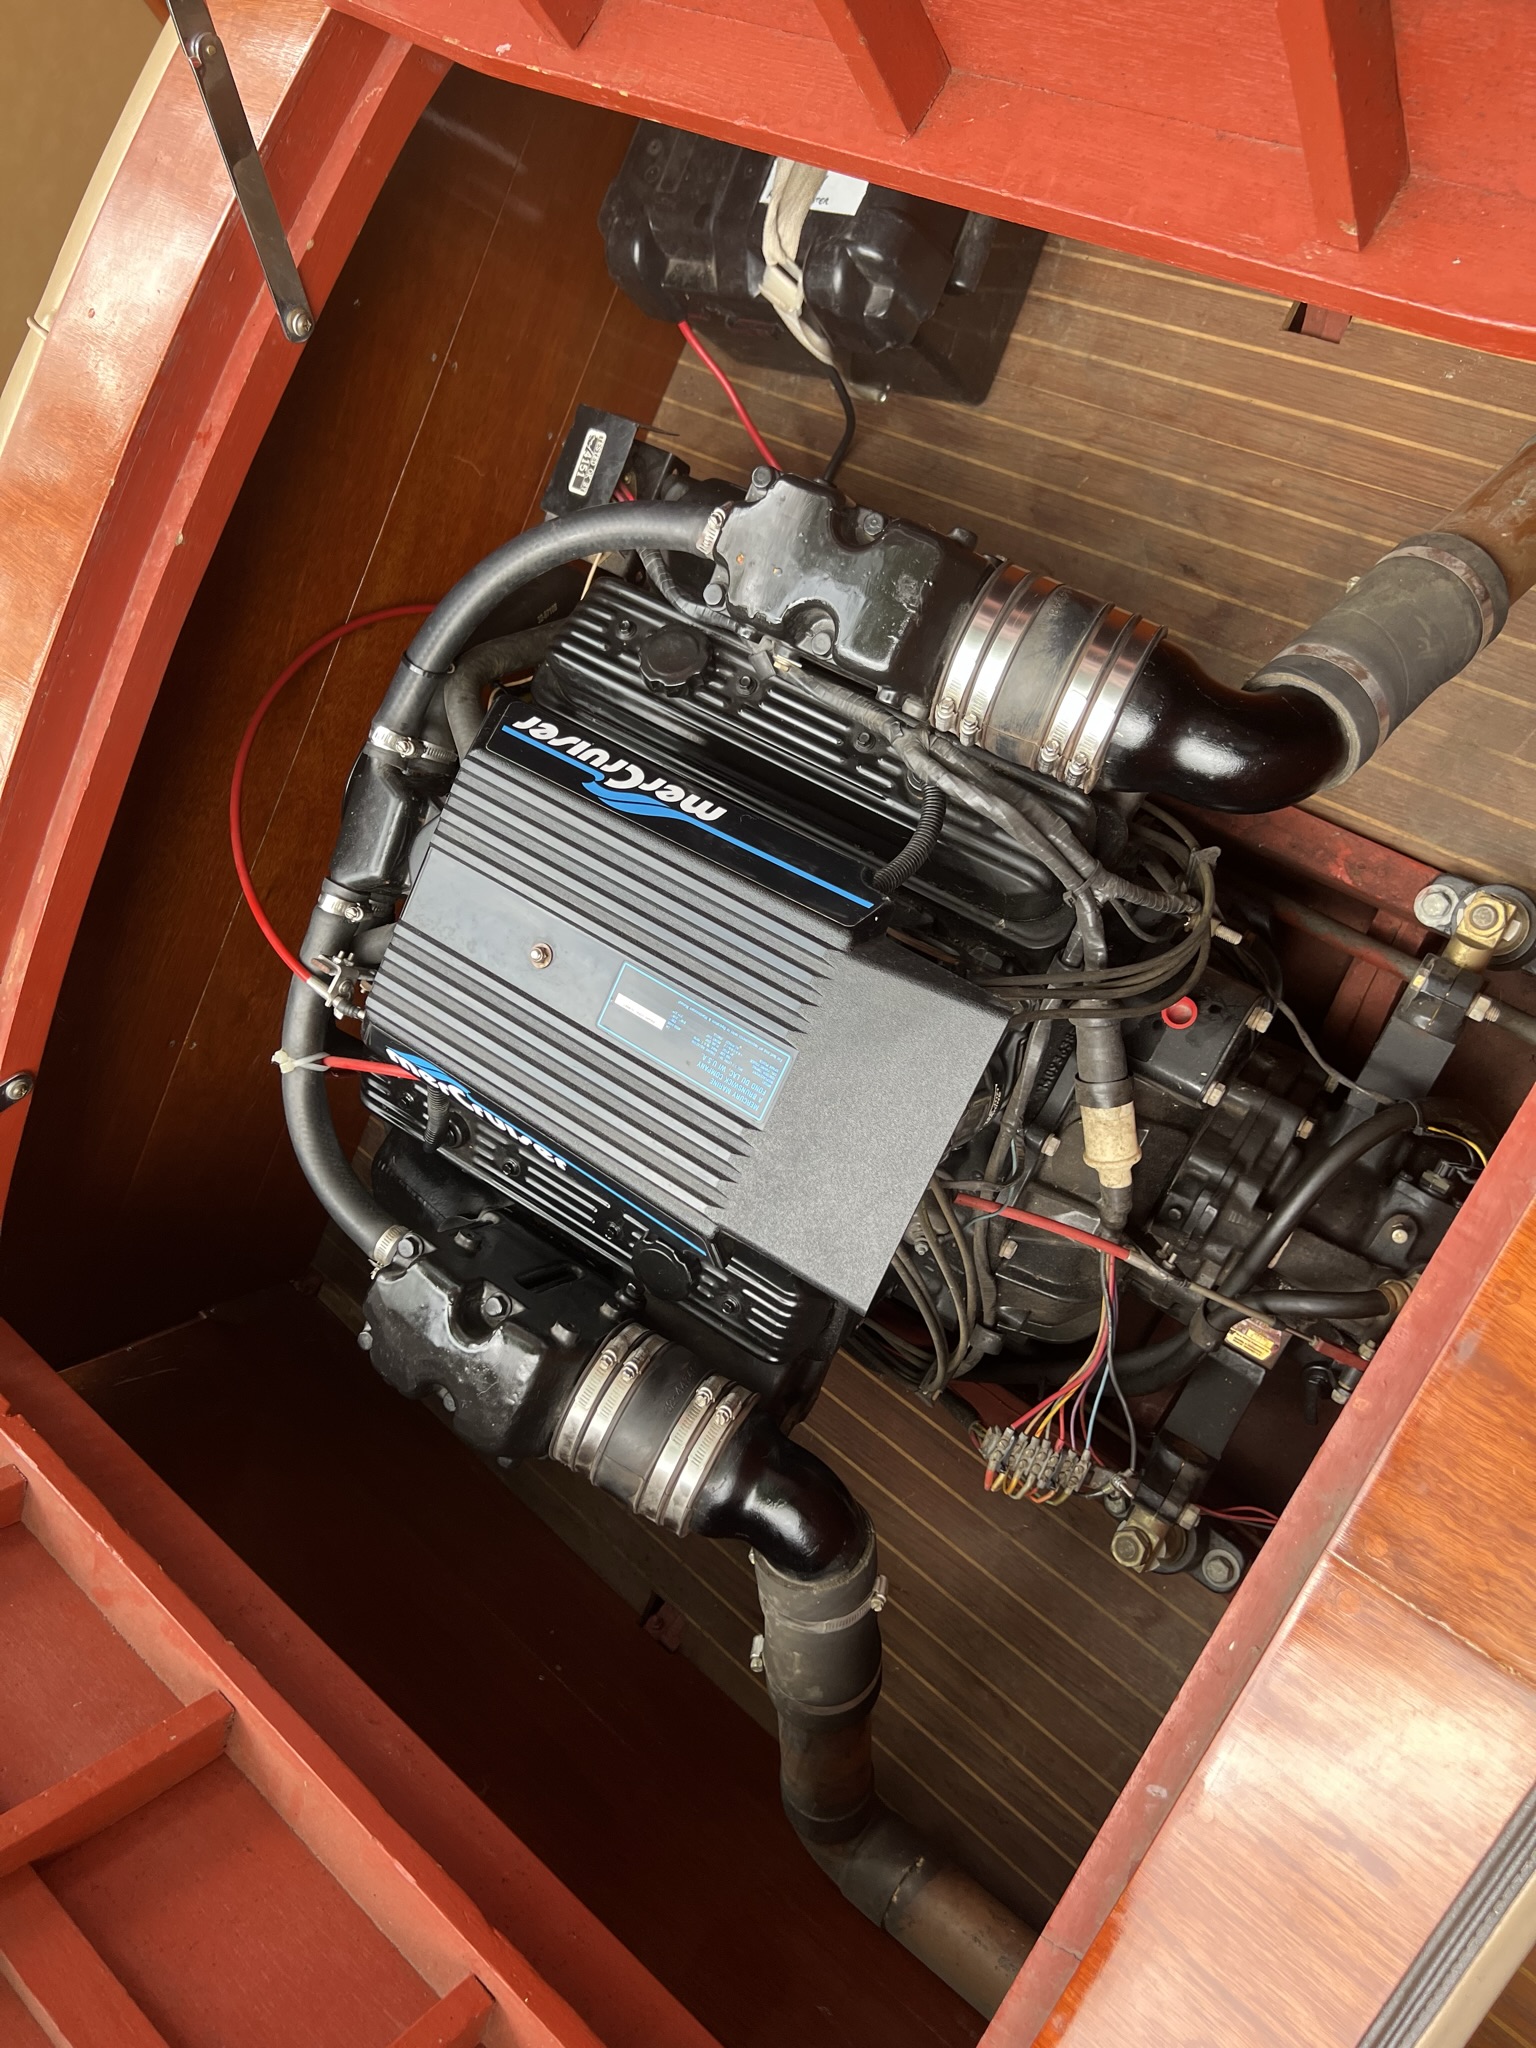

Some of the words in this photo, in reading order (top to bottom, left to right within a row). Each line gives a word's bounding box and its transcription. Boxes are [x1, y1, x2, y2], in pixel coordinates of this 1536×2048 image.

[577, 451, 591, 478] 4151
[512, 716, 728, 821] merCruiser
[696, 1060, 723, 1079] COMPANY
[709, 1077, 731, 1093] MARINE
[724, 1076, 756, 1099] BRUNSWICK
[740, 1077, 750, 1085] DU
[751, 1083, 766, 1095] FOND
[732, 1091, 759, 1110] MERCURY
